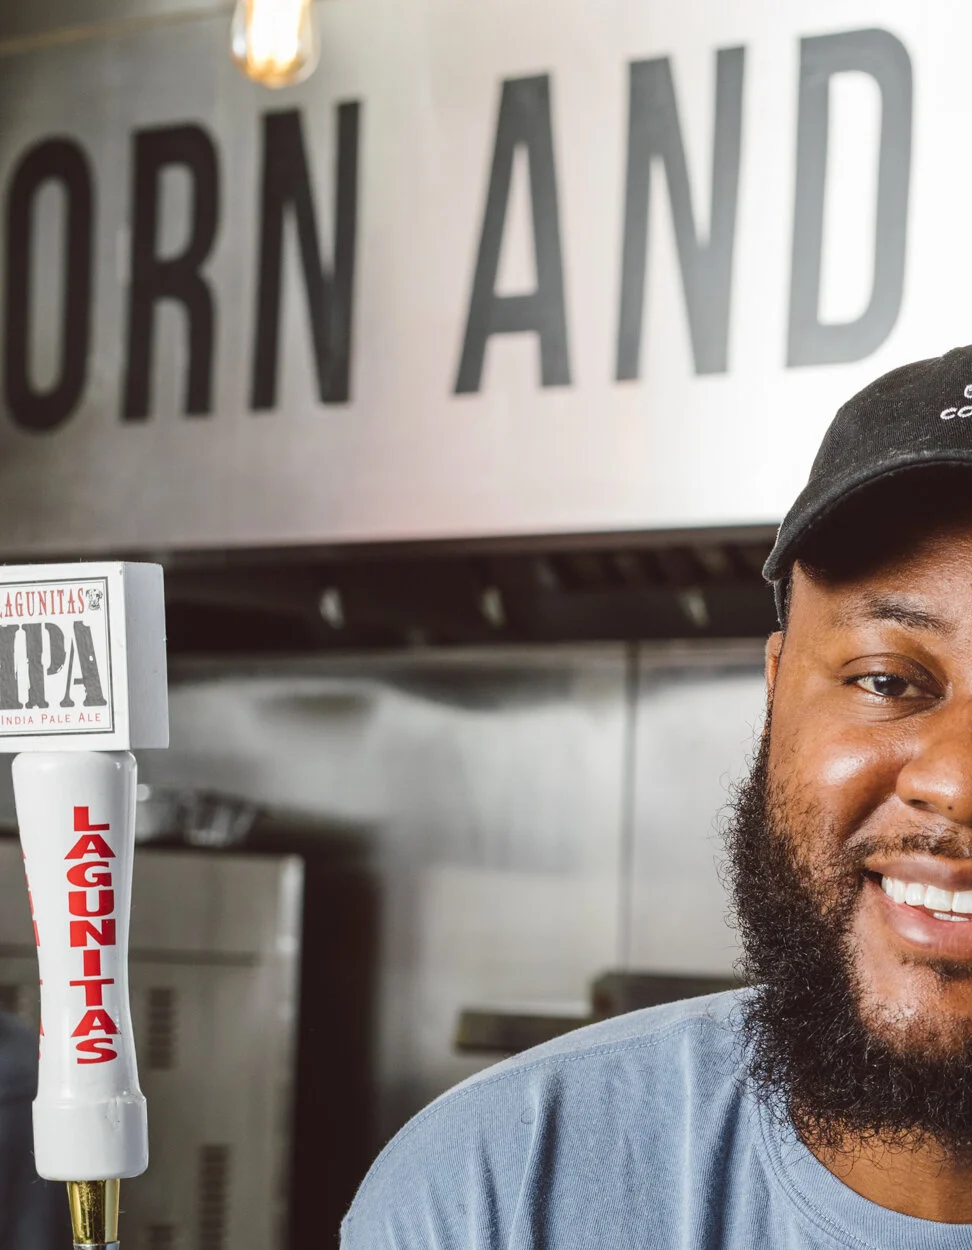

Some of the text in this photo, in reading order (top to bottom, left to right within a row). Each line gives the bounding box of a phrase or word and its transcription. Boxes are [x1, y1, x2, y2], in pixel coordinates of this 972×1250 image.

[454, 27, 914, 395] AND
[0, 587, 85, 619] AGUNITAS
[0, 620, 108, 710] IPA
[1, 712, 101, 725] INDIA PALE ALE
[64, 806, 120, 1064] LAGUNITAS
